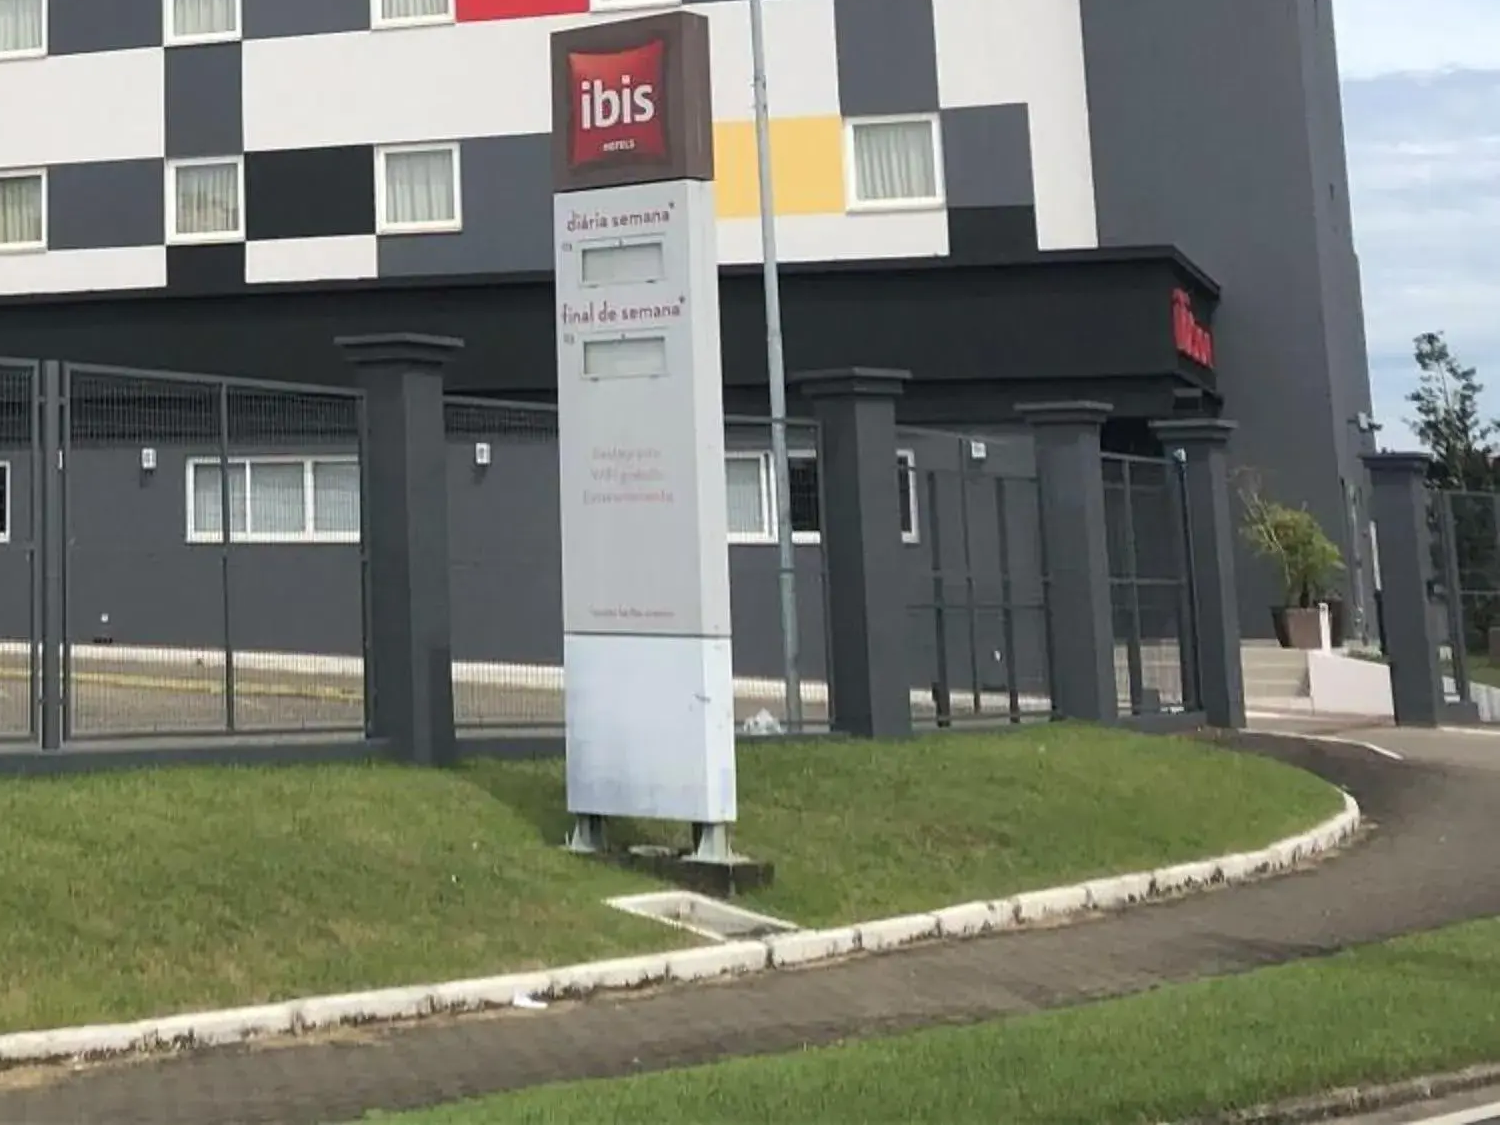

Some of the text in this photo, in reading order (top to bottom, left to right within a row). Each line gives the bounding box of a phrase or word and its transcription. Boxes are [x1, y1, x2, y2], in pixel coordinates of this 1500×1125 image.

[581, 75, 655, 130] ibis
[603, 138, 635, 152] HOTELS
[562, 301, 595, 324] final
[599, 299, 617, 322] de
